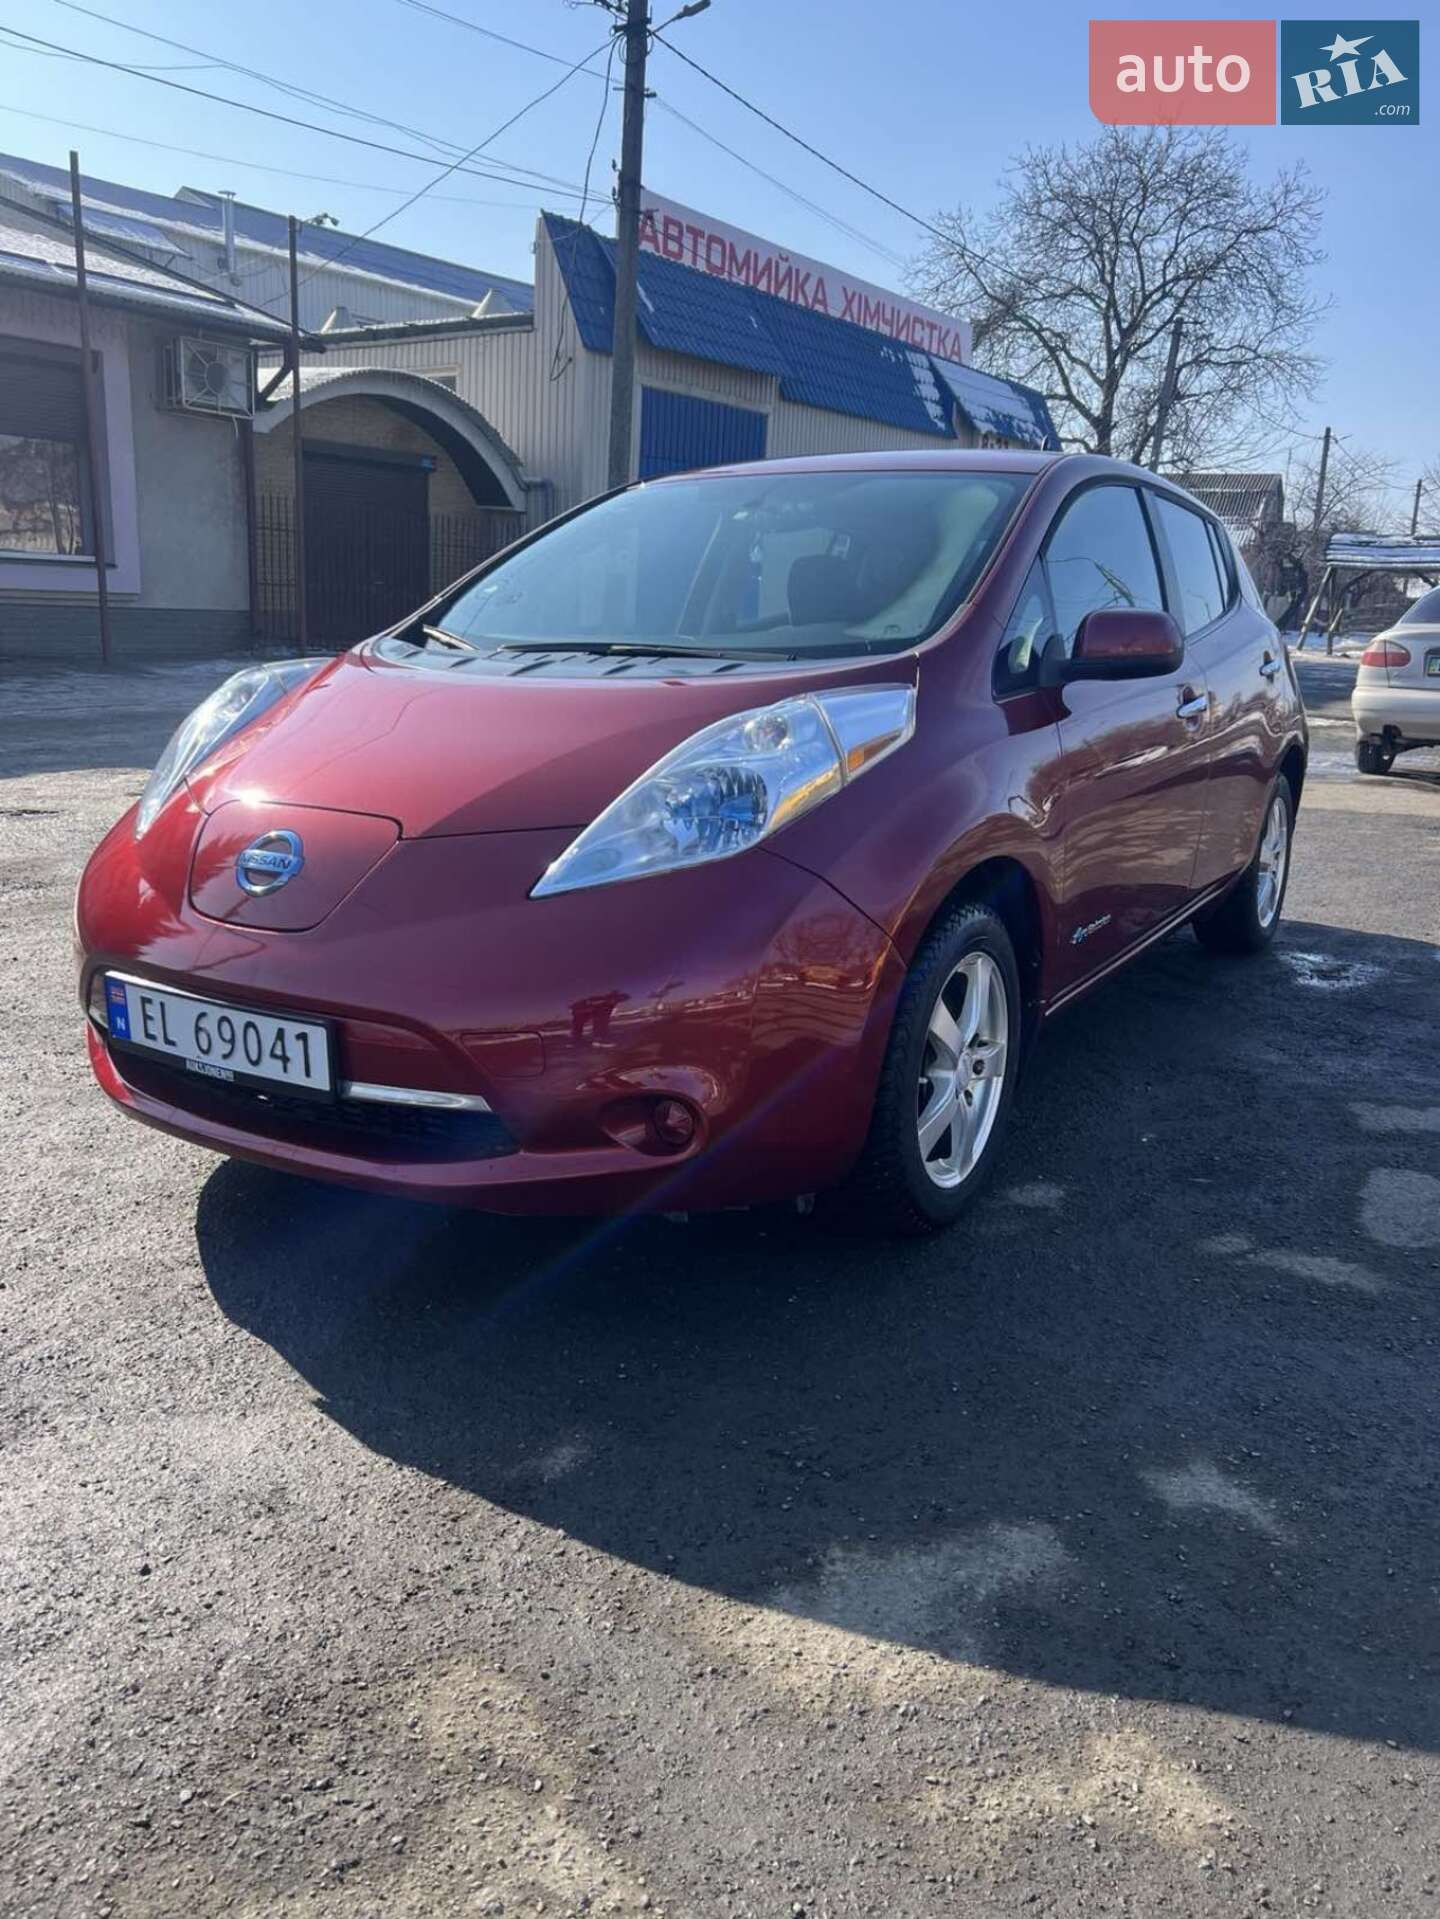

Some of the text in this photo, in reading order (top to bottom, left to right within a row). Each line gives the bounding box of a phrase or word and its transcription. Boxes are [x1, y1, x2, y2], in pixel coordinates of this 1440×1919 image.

[639, 210, 962, 363] АВТОМИЙКА ХІМЧИСТКА
[140, 996, 177, 1047] EL
[194, 1011, 312, 1078] 69041
